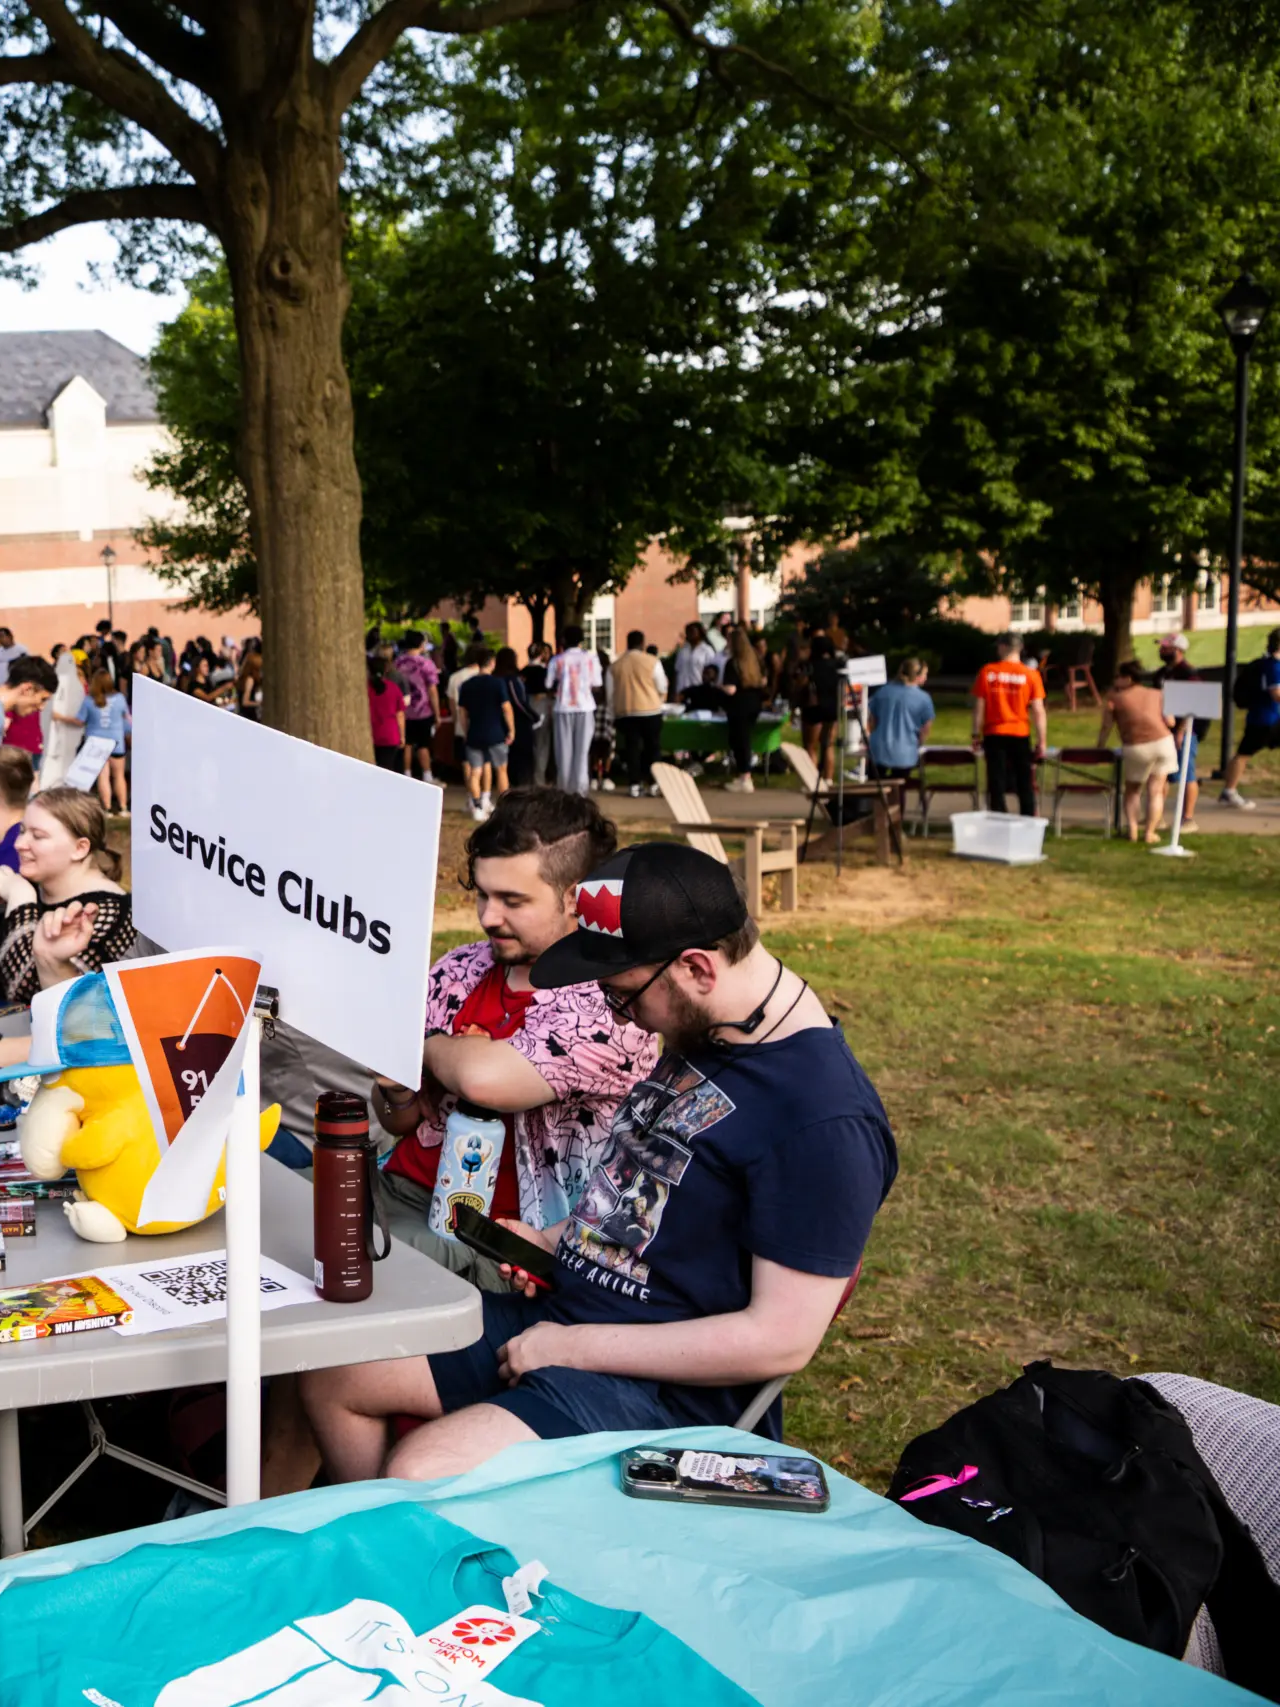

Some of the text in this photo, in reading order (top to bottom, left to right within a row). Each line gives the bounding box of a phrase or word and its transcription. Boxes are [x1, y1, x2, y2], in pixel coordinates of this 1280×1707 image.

[150, 804, 391, 955] Service Clubs
[181, 1069, 213, 1093] 91
[55, 1321, 73, 1334] MAN
[74, 1315, 116, 1332] CHAINSAW
[428, 1637, 487, 1668] CUSTOM
[435, 1648, 461, 1665] INK
